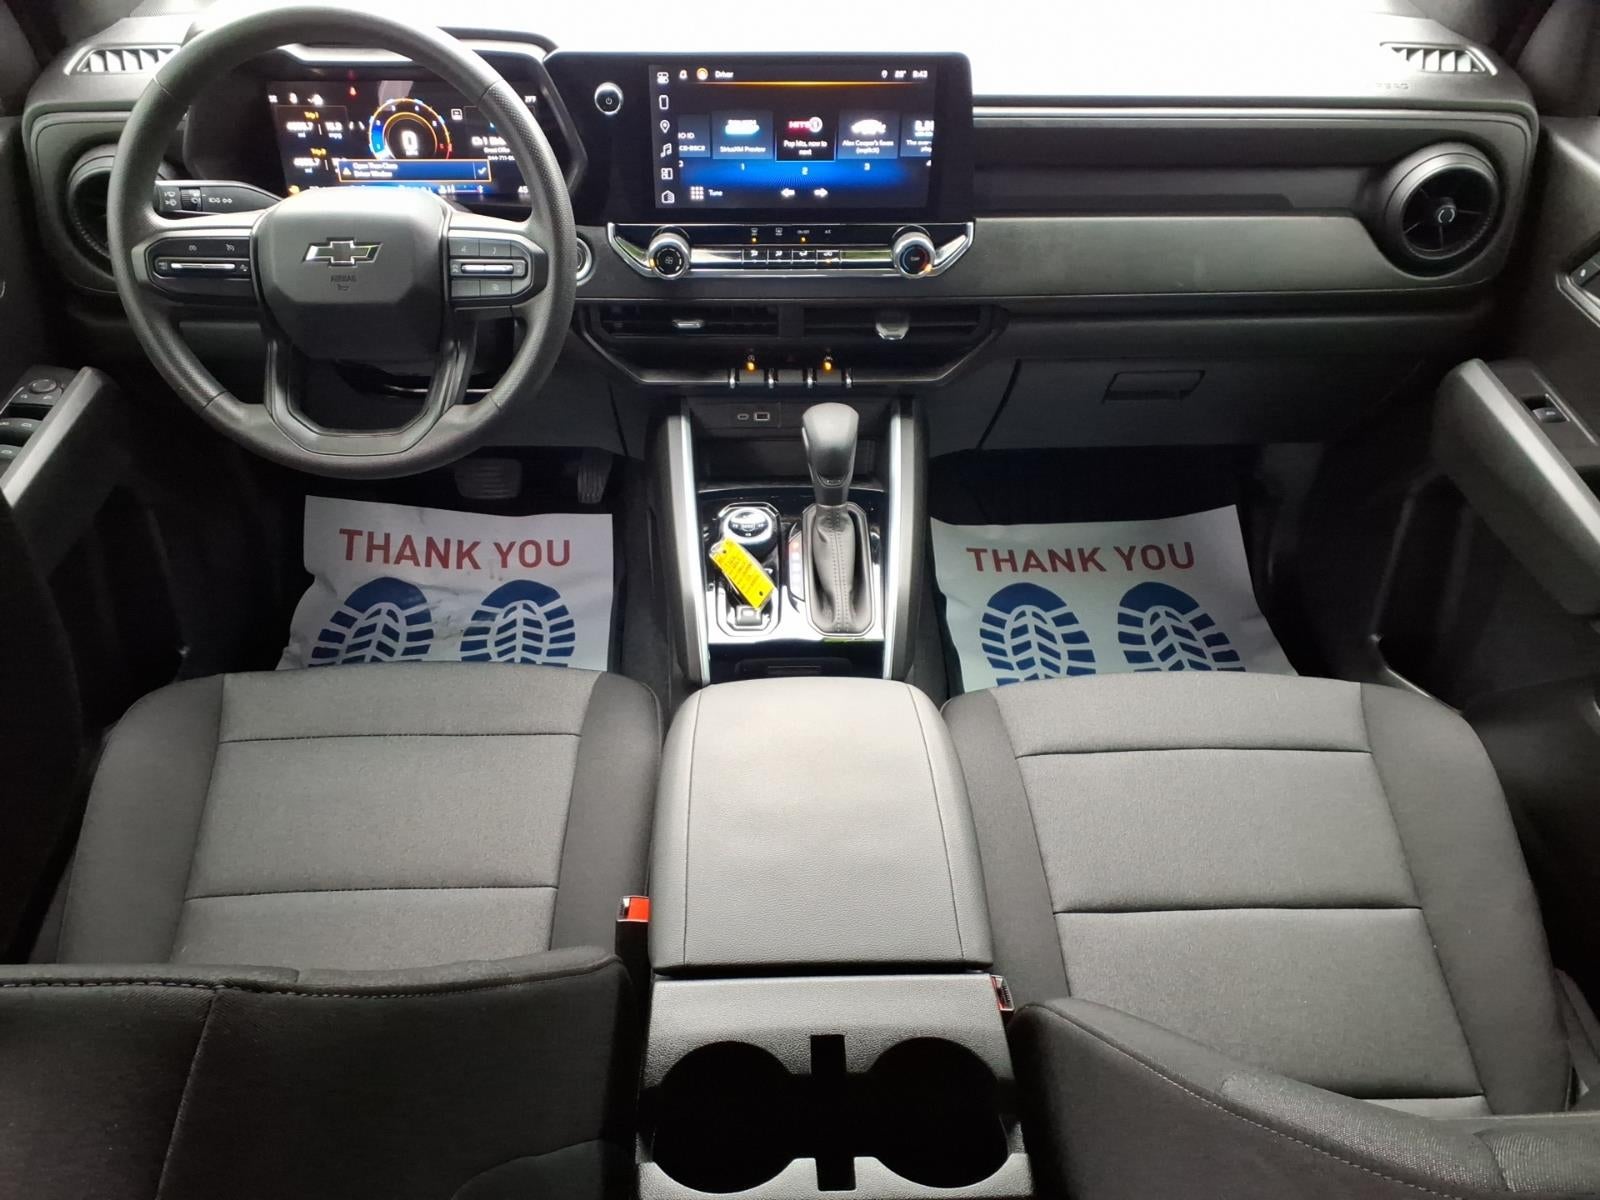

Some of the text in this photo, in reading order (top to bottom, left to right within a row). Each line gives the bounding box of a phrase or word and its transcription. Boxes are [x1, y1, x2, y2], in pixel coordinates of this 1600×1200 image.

[339, 528, 570, 570] THANK YOU
[966, 541, 1195, 572] THANK YOU
